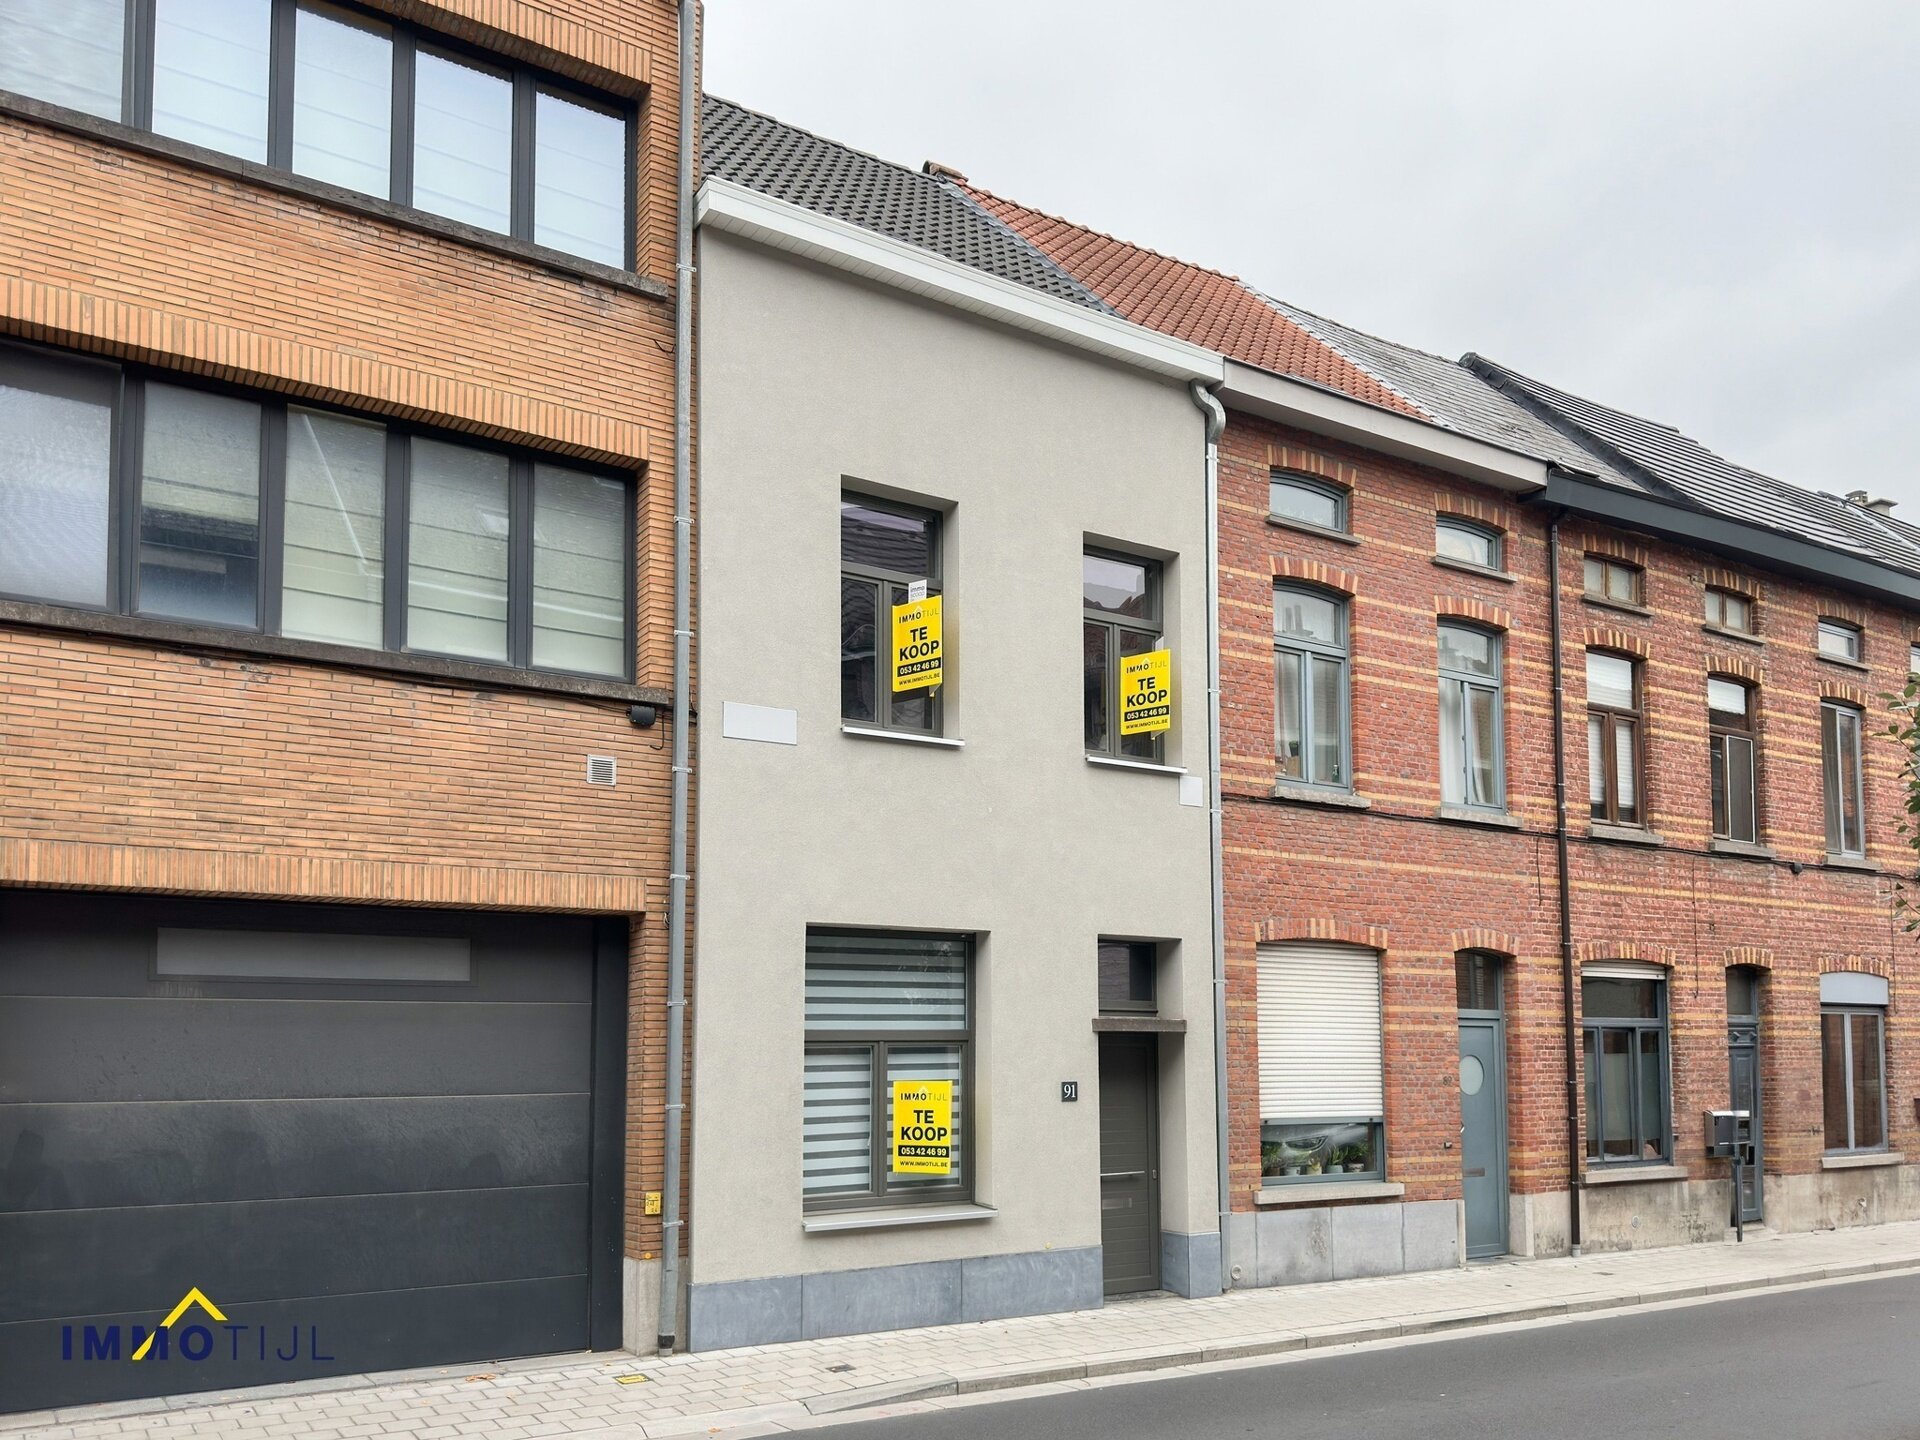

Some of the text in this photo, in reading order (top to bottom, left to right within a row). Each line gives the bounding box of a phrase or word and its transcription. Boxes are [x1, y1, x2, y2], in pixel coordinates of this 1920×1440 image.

[899, 608, 940, 624] IMMOTIJL
[910, 626, 928, 642] TE
[900, 640, 940, 661] KOOP
[900, 660, 939, 675] 053 42 46 99
[1126, 662, 1167, 674] IMMOTIJL
[899, 672, 940, 686] WWW.IMMOTIJL.BE
[1137, 677, 1155, 691] TE
[1126, 689, 1167, 707] KOOP
[1127, 712, 1139, 720] 053
[1140, 710, 1148, 718] 42
[1126, 719, 1168, 729] WWW.IMMOTIJL.BE
[900, 1092, 948, 1101] IMMOTIJL
[1064, 1084, 1076, 1098] 91
[913, 1110, 934, 1124] TE
[901, 1126, 948, 1141] KOOP
[901, 1147, 947, 1156] 053 42 46 99
